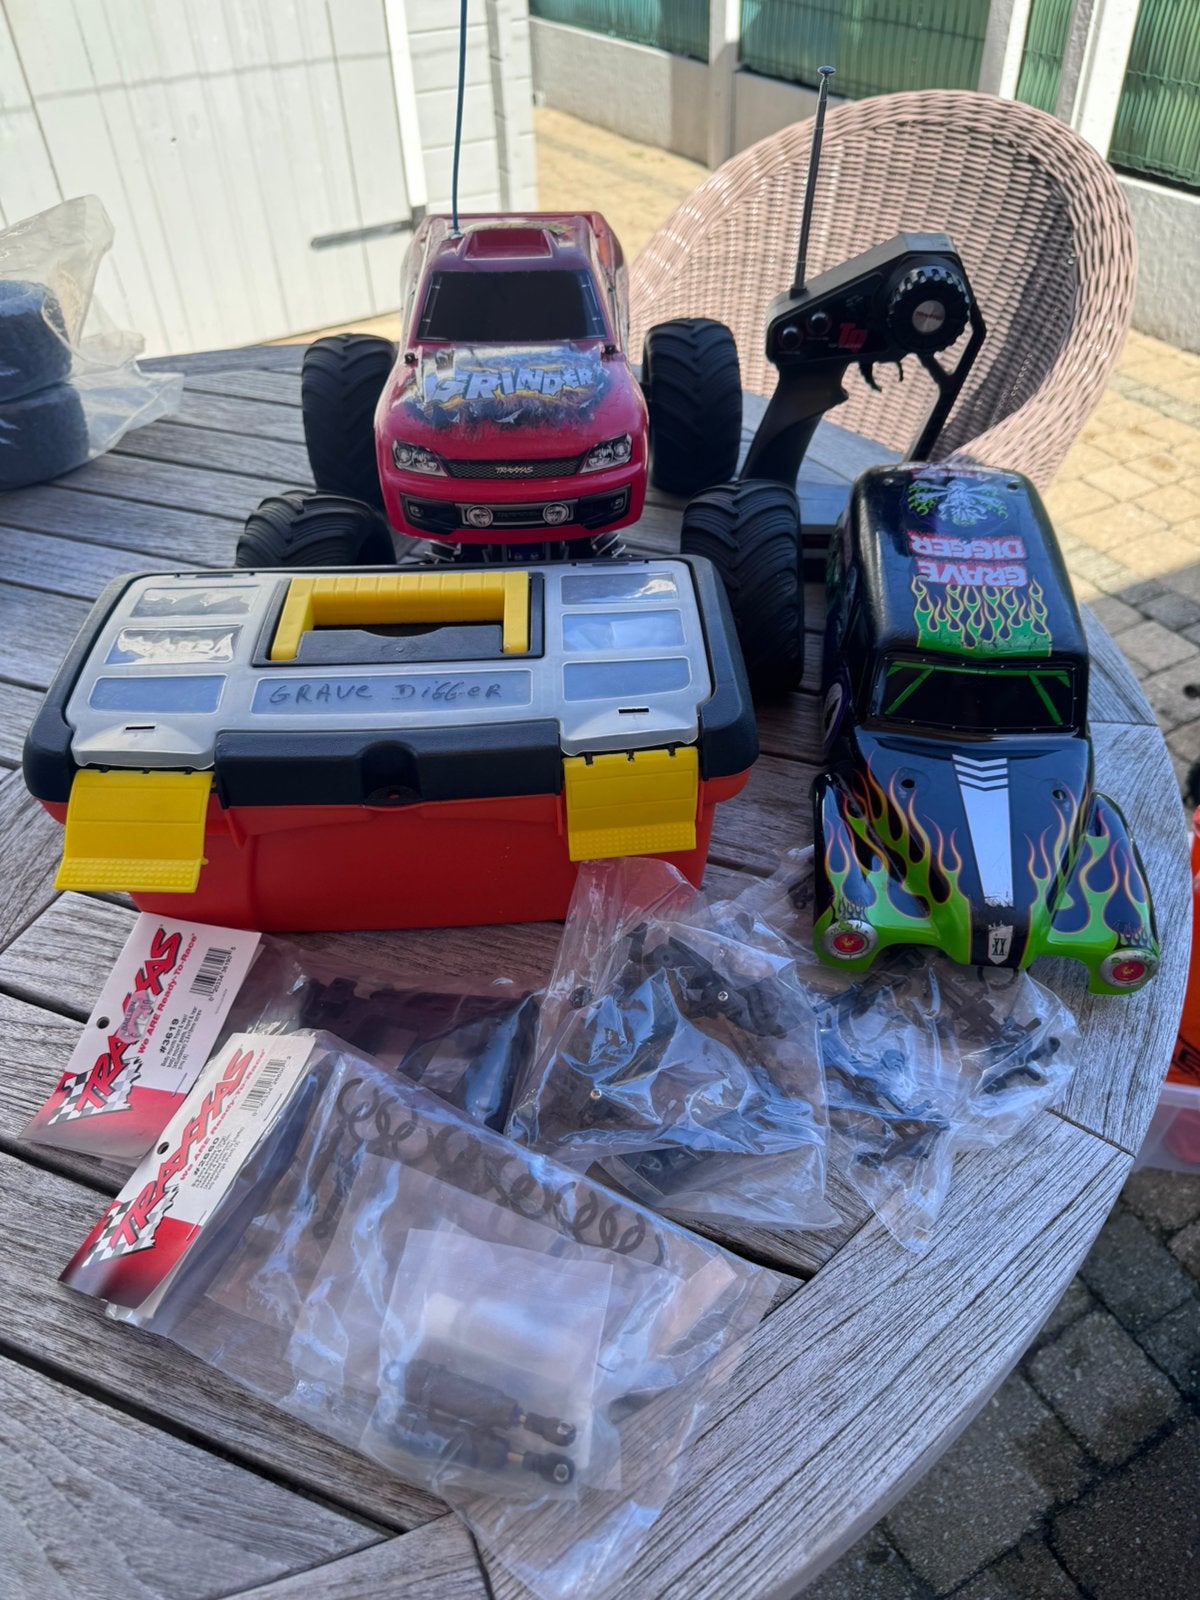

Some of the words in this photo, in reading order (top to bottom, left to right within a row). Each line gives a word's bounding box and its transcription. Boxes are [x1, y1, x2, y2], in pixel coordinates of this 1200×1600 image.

[424, 366, 595, 402] GRINDER
[910, 535, 1025, 560] DIGGER
[915, 560, 1027, 587] GRAVE
[137, 1038, 150, 1054] We
[146, 1017, 161, 1036] ARE
[159, 1018, 180, 1054] #3619
[109, 1048, 255, 1249] TRAXXAS
[193, 1136, 220, 1175] #2660
